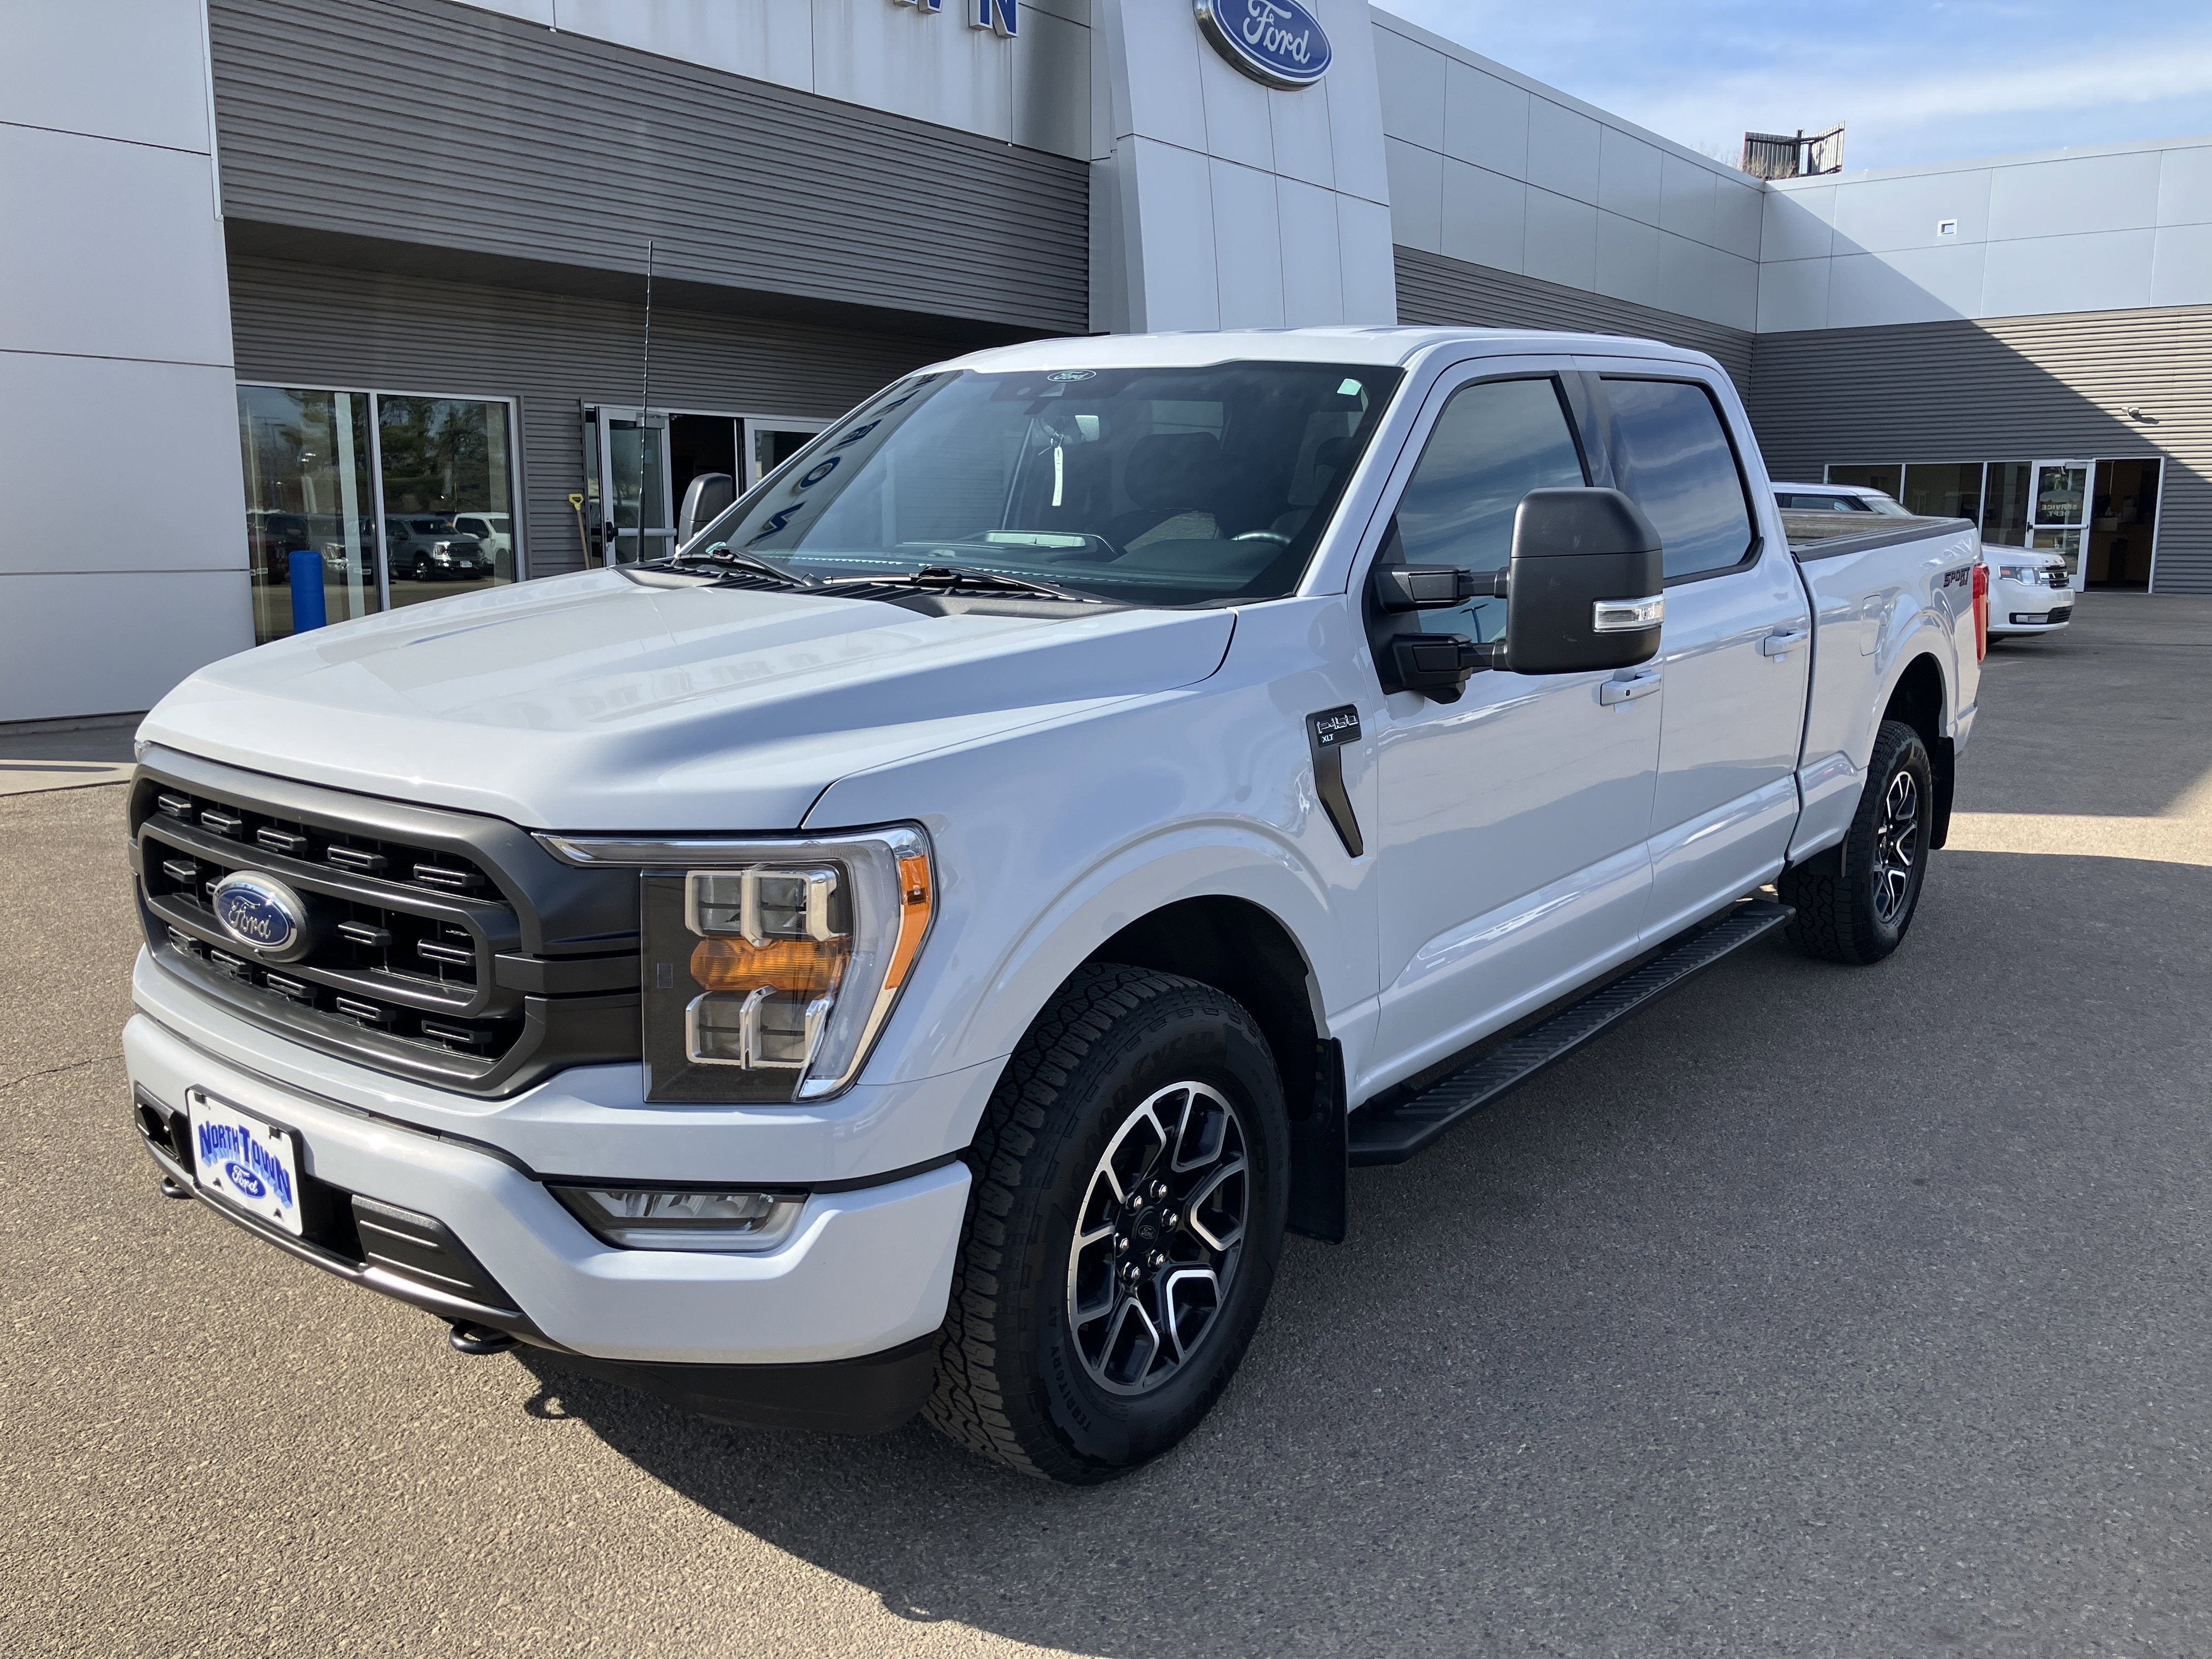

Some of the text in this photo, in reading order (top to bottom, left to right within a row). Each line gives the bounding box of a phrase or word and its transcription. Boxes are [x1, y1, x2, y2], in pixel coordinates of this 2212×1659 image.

[1243, 0, 1310, 64] Ford
[1053, 371, 1089, 380] Ford
[1943, 567, 1970, 588] SPORT
[1322, 733, 1334, 743] XLT
[229, 896, 272, 939] Ford
[232, 1165, 258, 1194] Ford
[1049, 1345, 1092, 1432] TERRITORY
